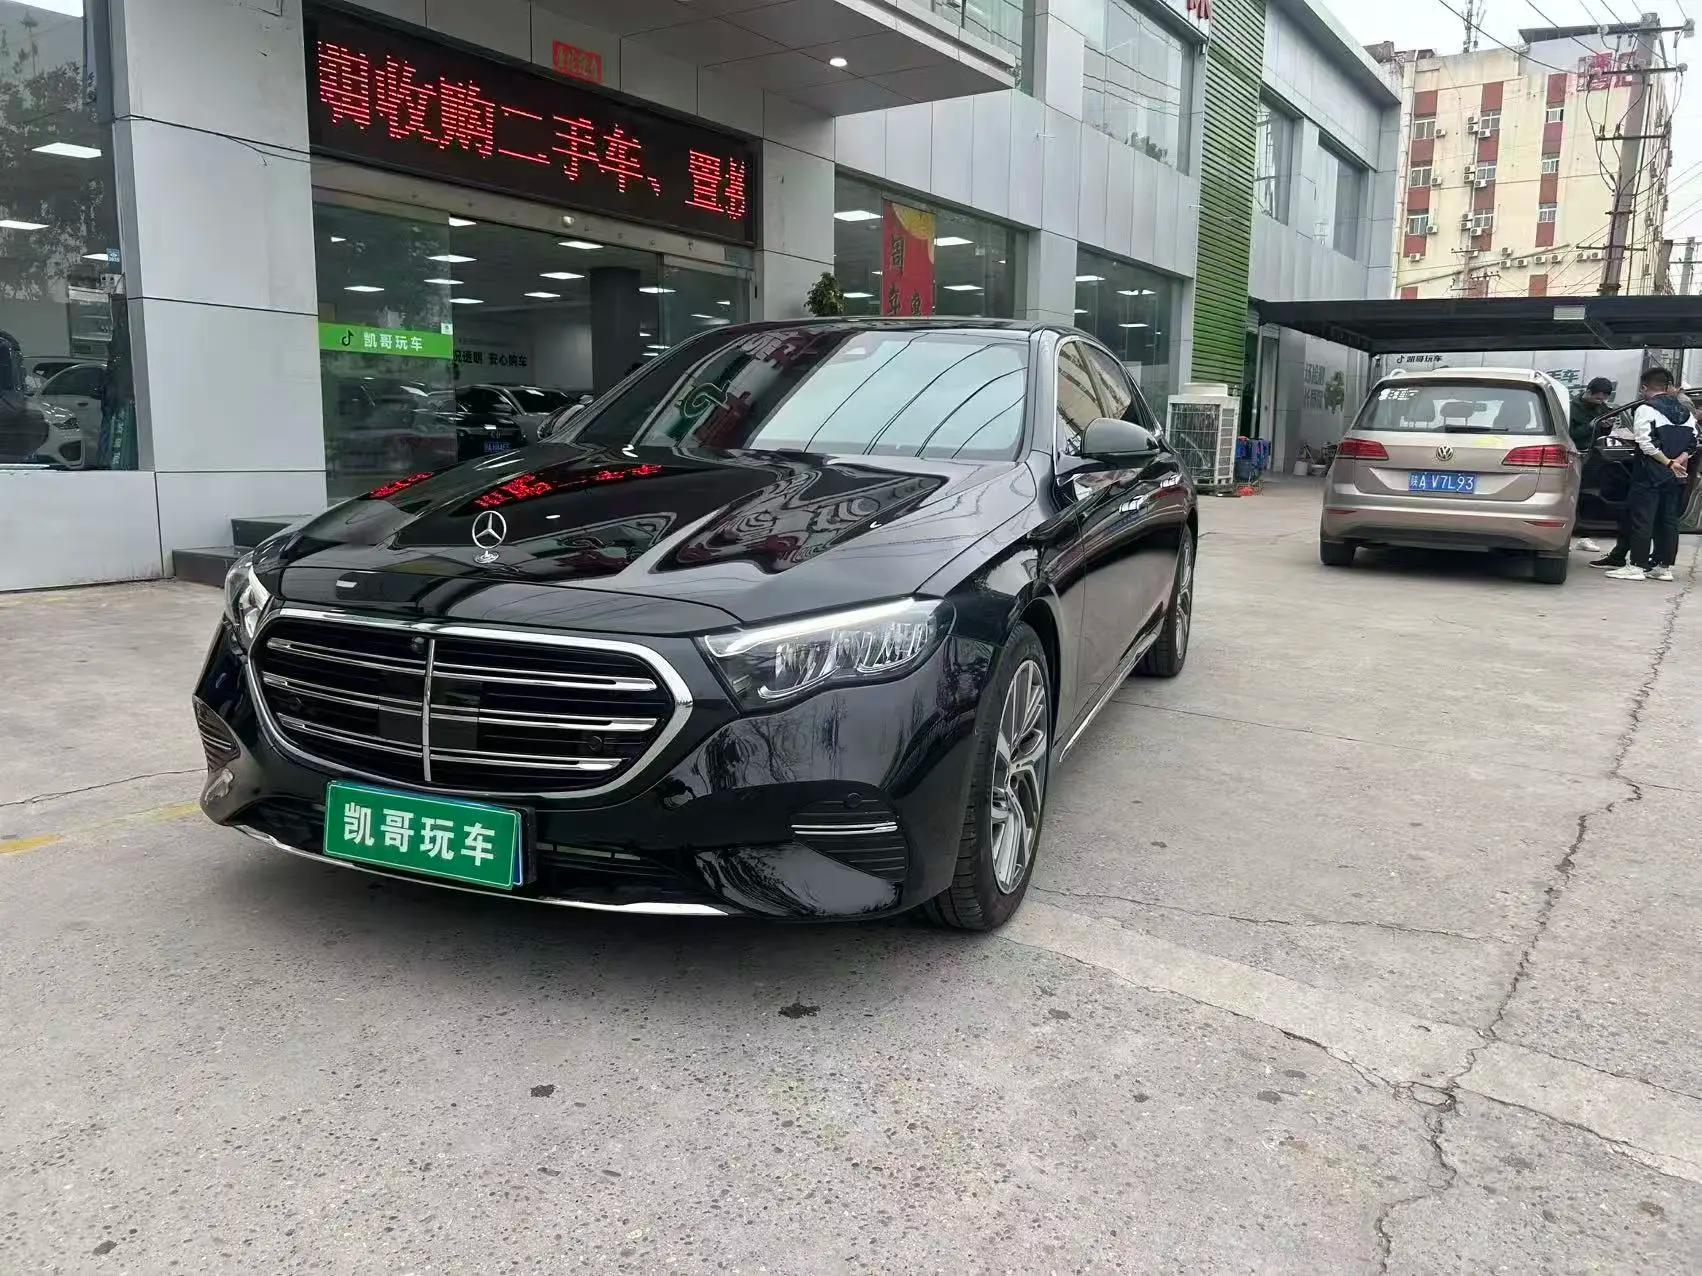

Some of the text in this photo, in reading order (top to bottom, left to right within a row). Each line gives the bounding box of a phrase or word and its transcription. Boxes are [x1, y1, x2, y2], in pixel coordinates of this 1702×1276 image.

[363, 332, 423, 352] 凯哥玩车
[1406, 354, 1443, 363] 凯哥玩车
[343, 801, 496, 867] 凯哥玩车
